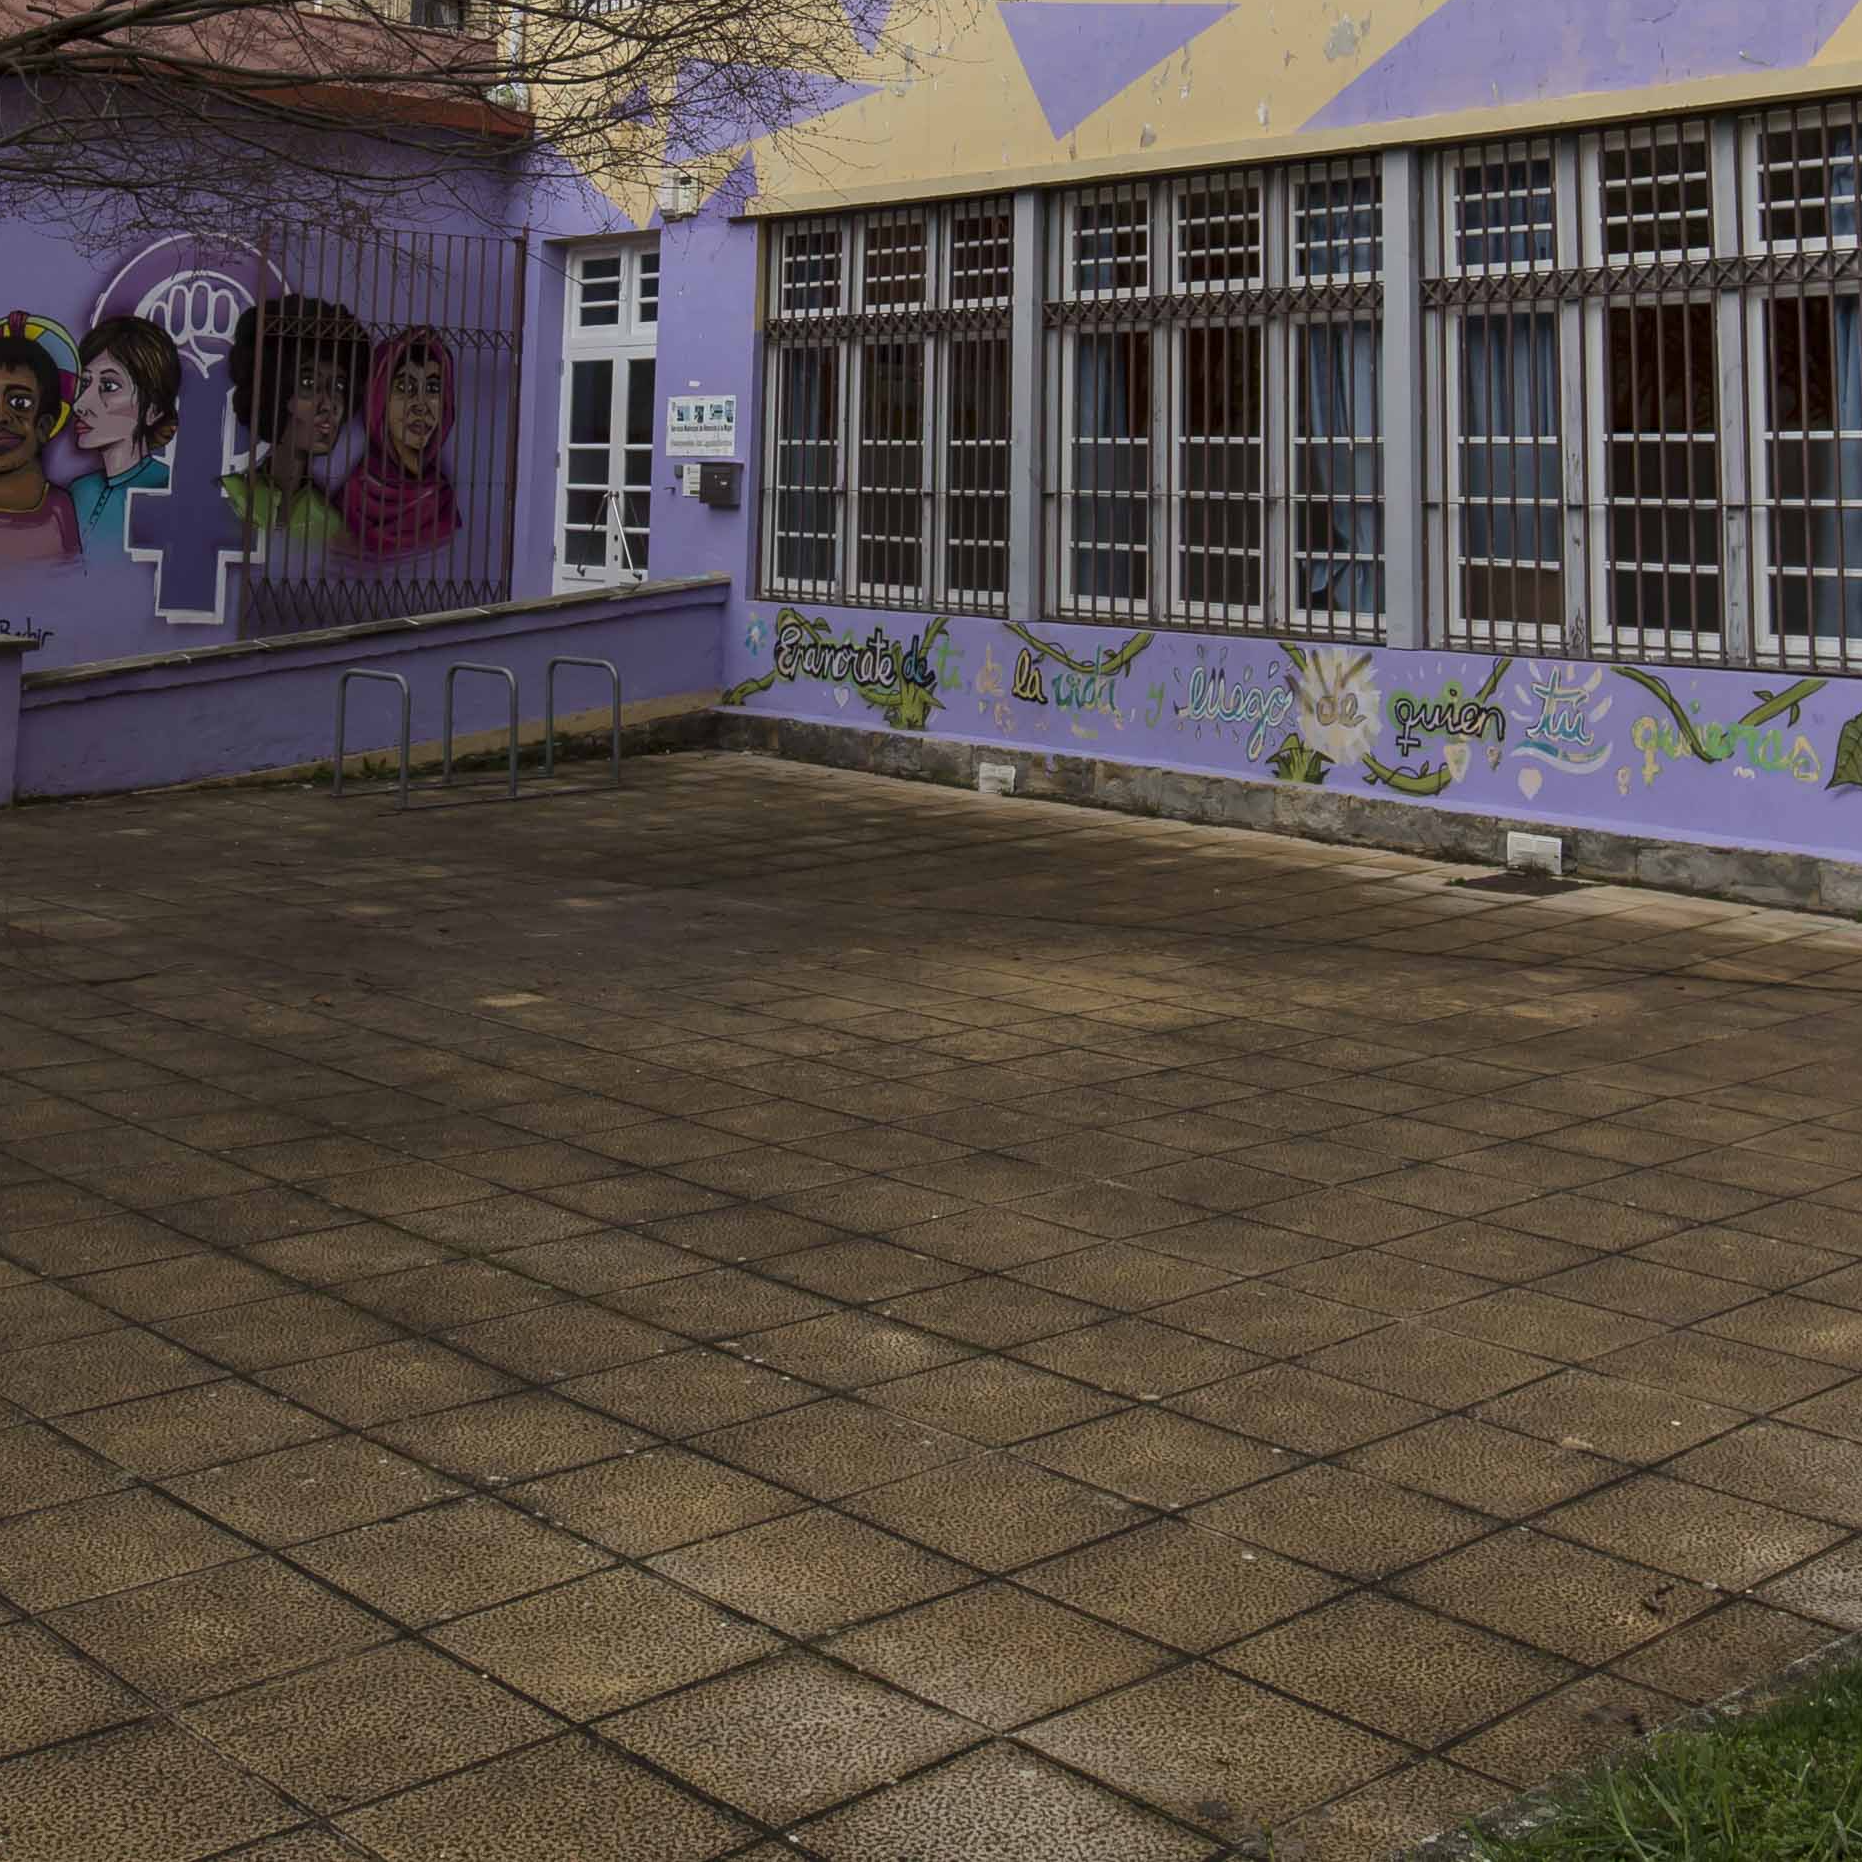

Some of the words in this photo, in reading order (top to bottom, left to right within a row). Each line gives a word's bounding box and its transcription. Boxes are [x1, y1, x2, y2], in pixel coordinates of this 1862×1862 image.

[902, 634, 936, 687] de
[1011, 648, 1048, 704] la
[1145, 682, 1165, 729] y
[1189, 666, 1294, 762] luego
